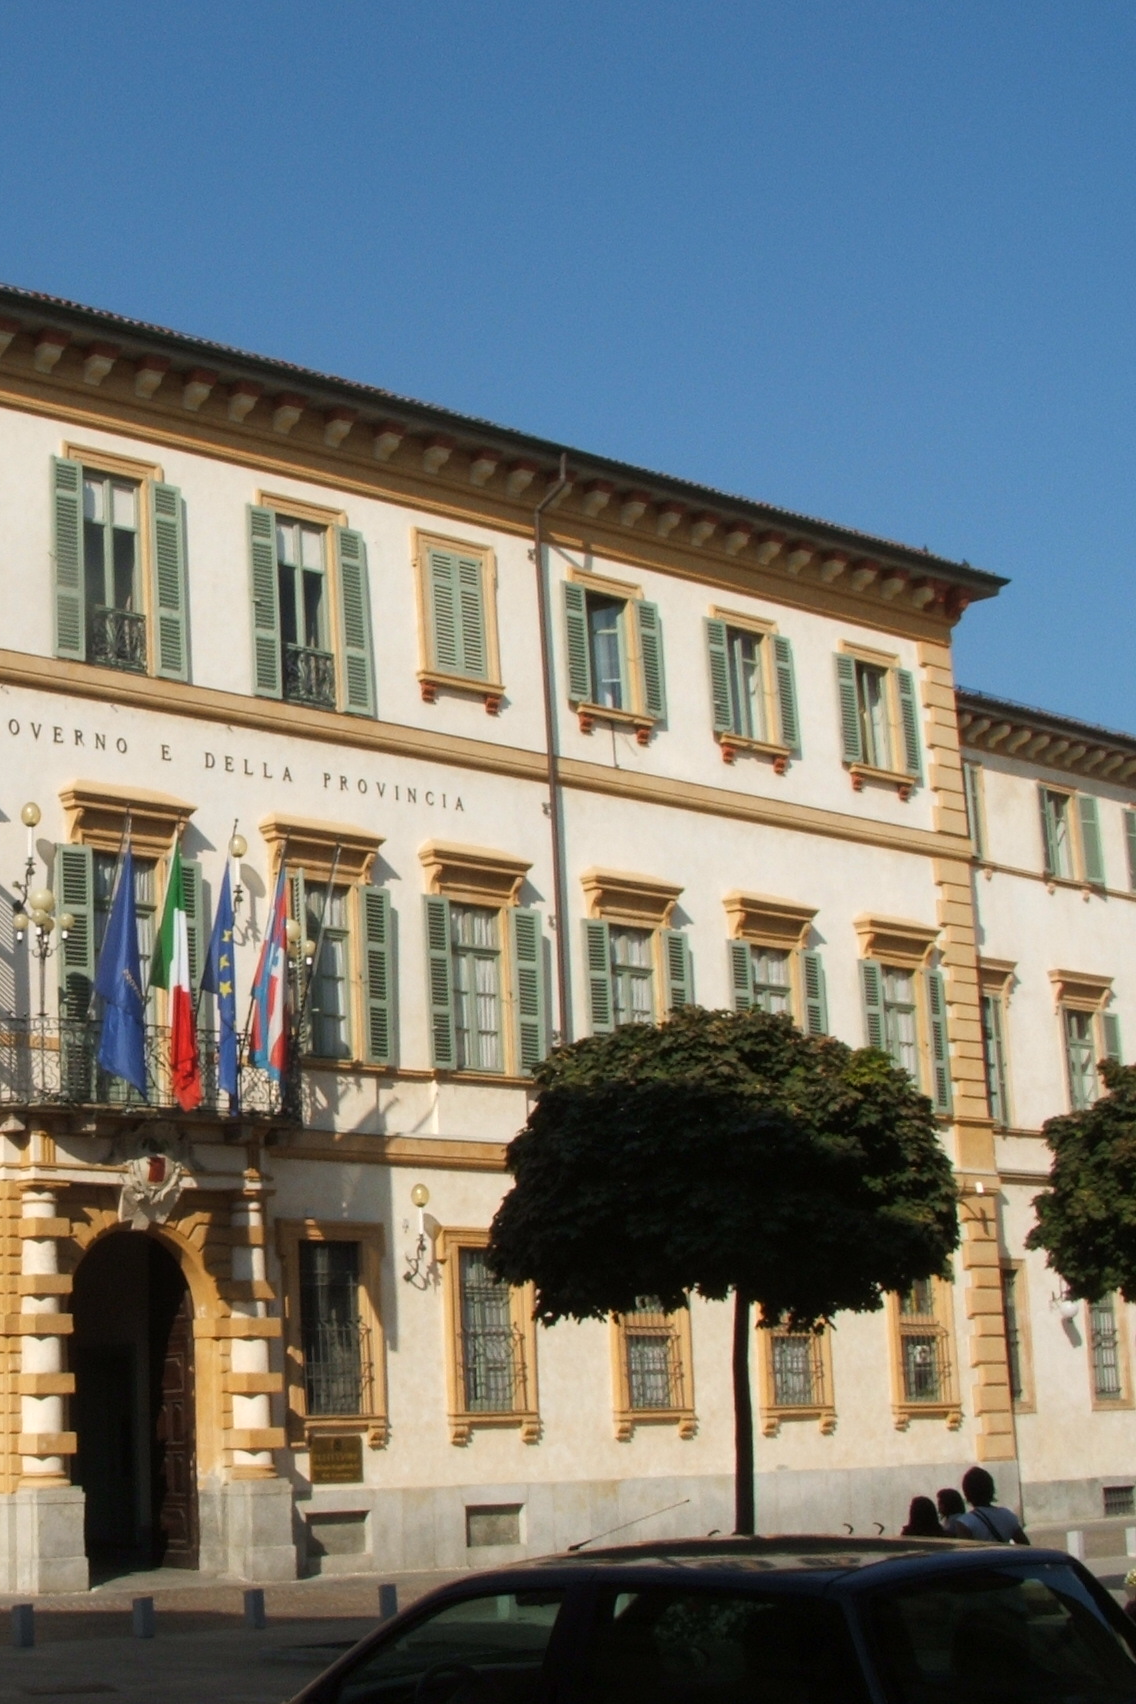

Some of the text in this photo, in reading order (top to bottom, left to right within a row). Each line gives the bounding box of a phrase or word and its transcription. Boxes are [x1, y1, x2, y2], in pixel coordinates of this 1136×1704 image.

[161, 744, 172, 762] E
[204, 751, 294, 783] DELLA
[323, 772, 467, 813] PROVINCIA
